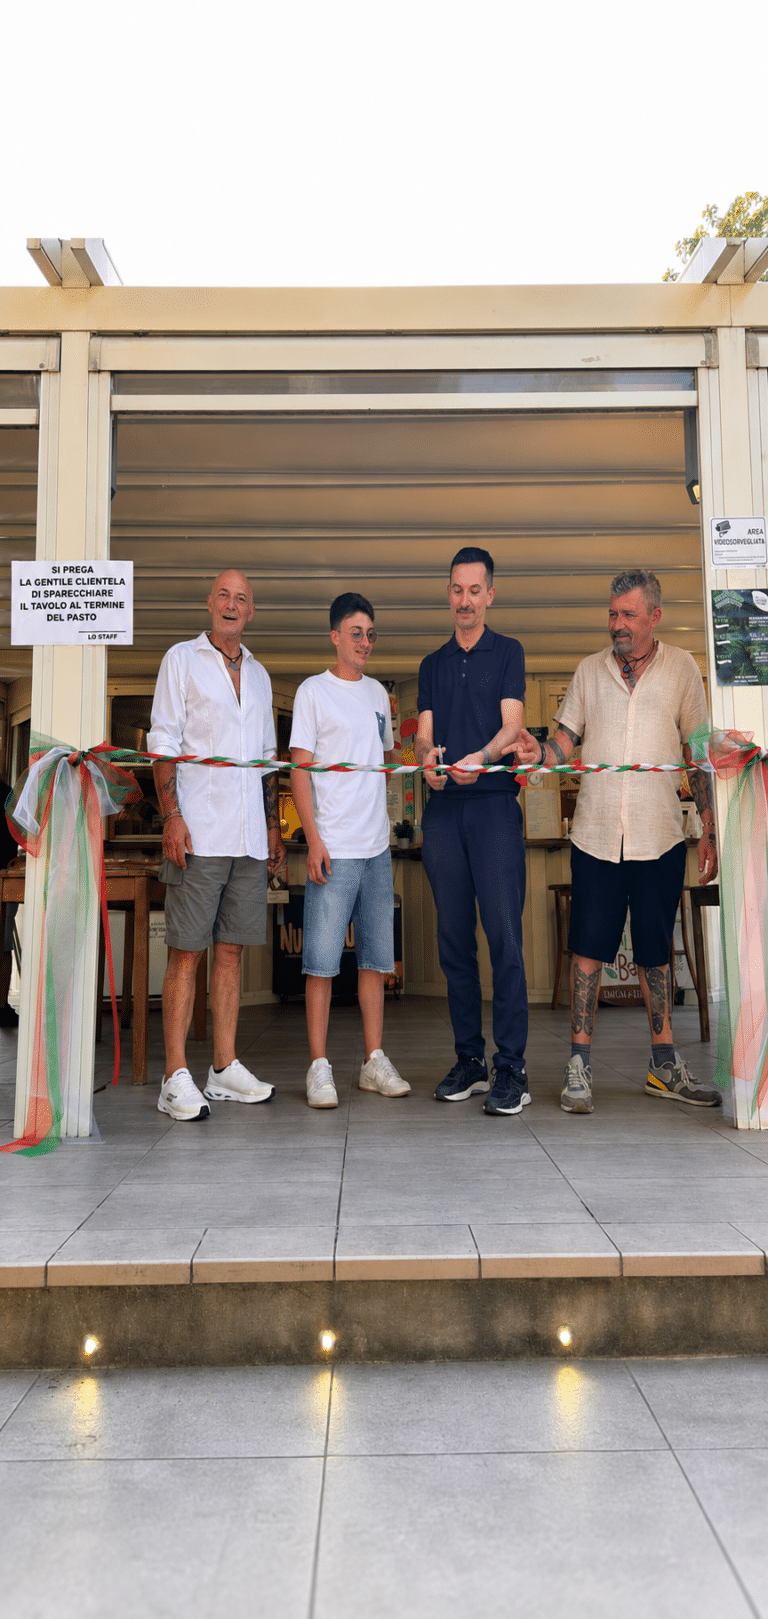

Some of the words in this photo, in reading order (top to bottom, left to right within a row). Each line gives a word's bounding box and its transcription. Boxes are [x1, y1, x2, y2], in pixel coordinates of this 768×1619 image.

[51, 566, 60, 574] SI
[63, 565, 94, 574] PREGA
[20, 578, 32, 587] LA
[34, 577, 73, 586] GENTILE
[75, 577, 126, 586] CLIENTELA
[32, 590, 41, 598] DI
[43, 589, 114, 598] SPARECCHIARE
[20, 602, 28, 610] IL
[31, 602, 67, 610] TAVOLO
[69, 601, 82, 609] AL
[84, 601, 125, 609] TERMINE
[47, 613, 65, 622] DEL
[67, 613, 97, 621] PASTO
